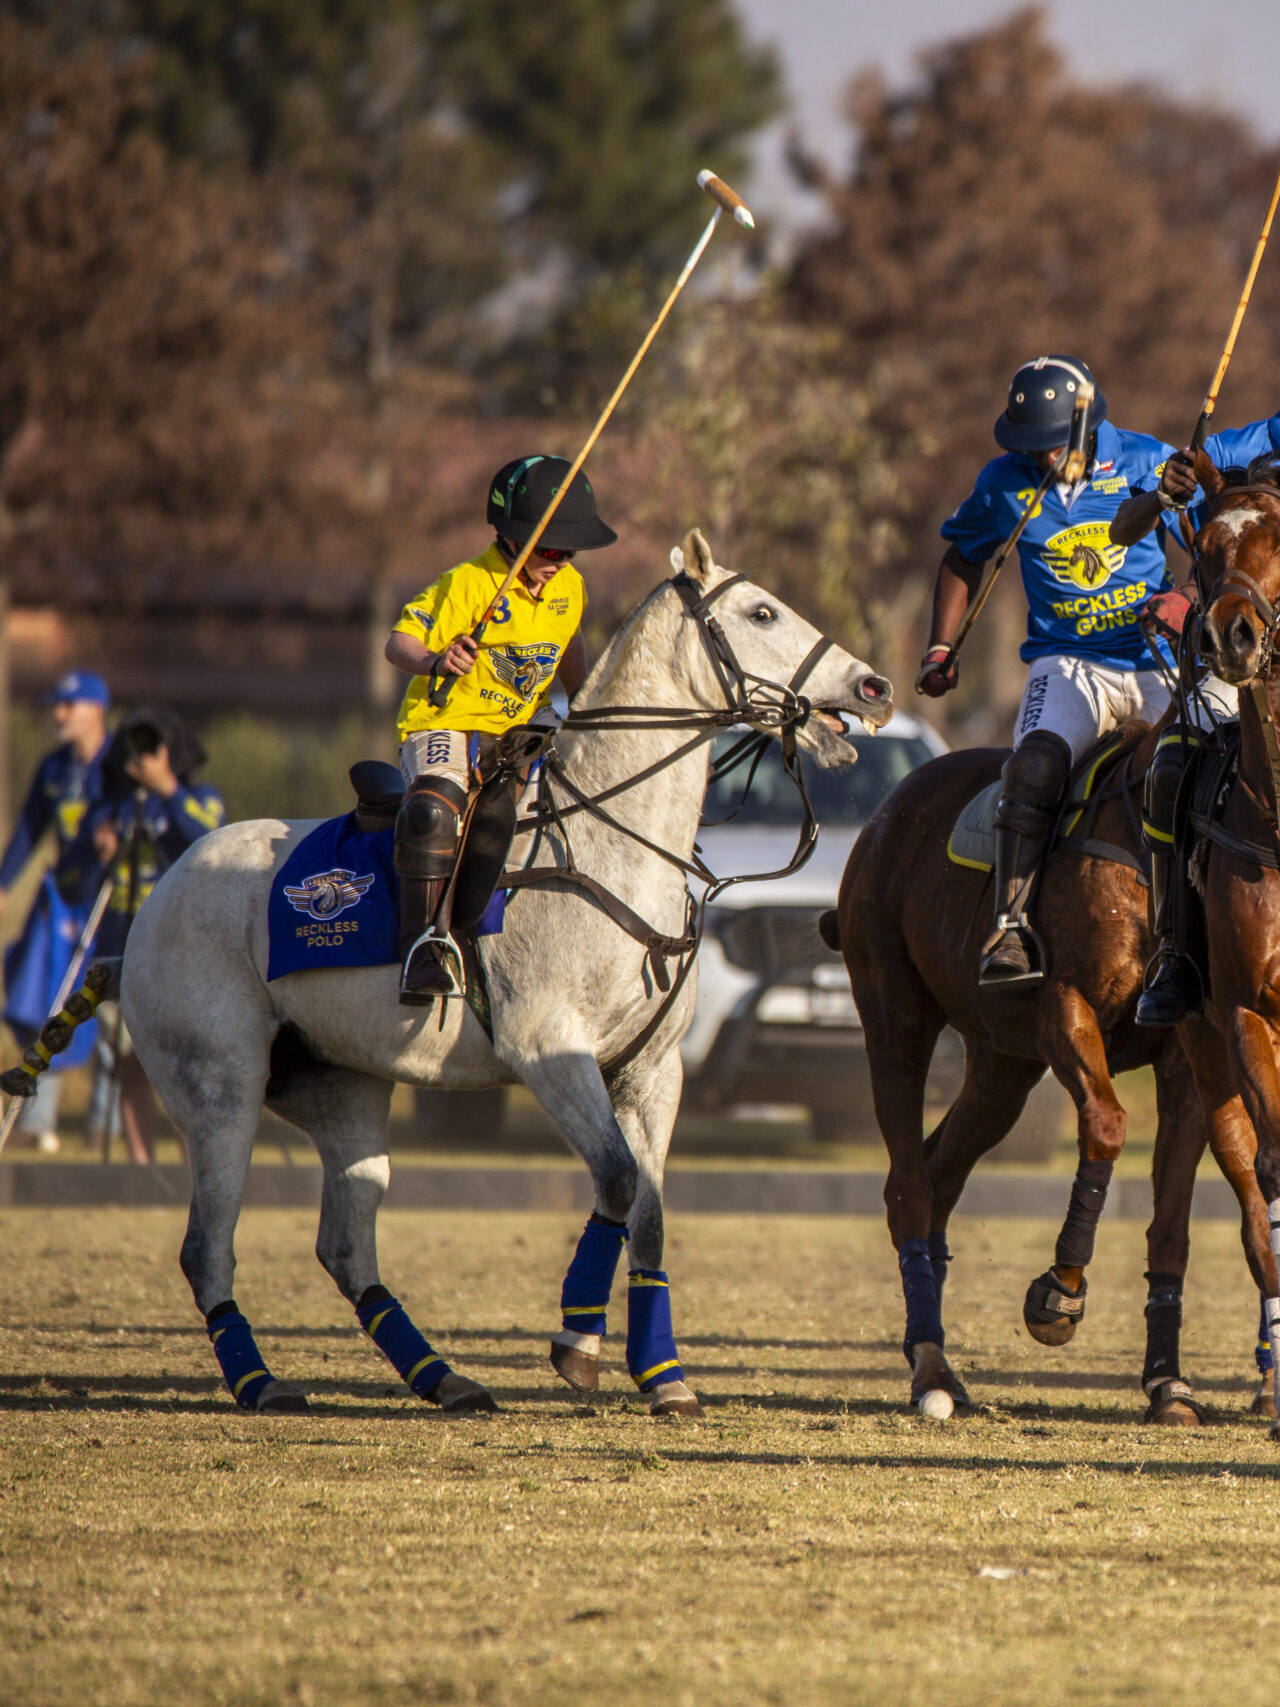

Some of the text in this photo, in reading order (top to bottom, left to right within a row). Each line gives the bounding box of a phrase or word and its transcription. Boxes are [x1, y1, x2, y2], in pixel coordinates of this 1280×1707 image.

[1017, 487, 1042, 519] 3
[1056, 526, 1106, 545] RECKLESS
[491, 595, 512, 624] 3
[1052, 581, 1147, 620] RECKLESS
[1076, 607, 1138, 637] GUNS
[480, 688, 545, 712] RECKLES
[1021, 674, 1049, 733] RECKLESS
[296, 920, 360, 938] RECKLESS
[307, 934, 344, 948] POLO
